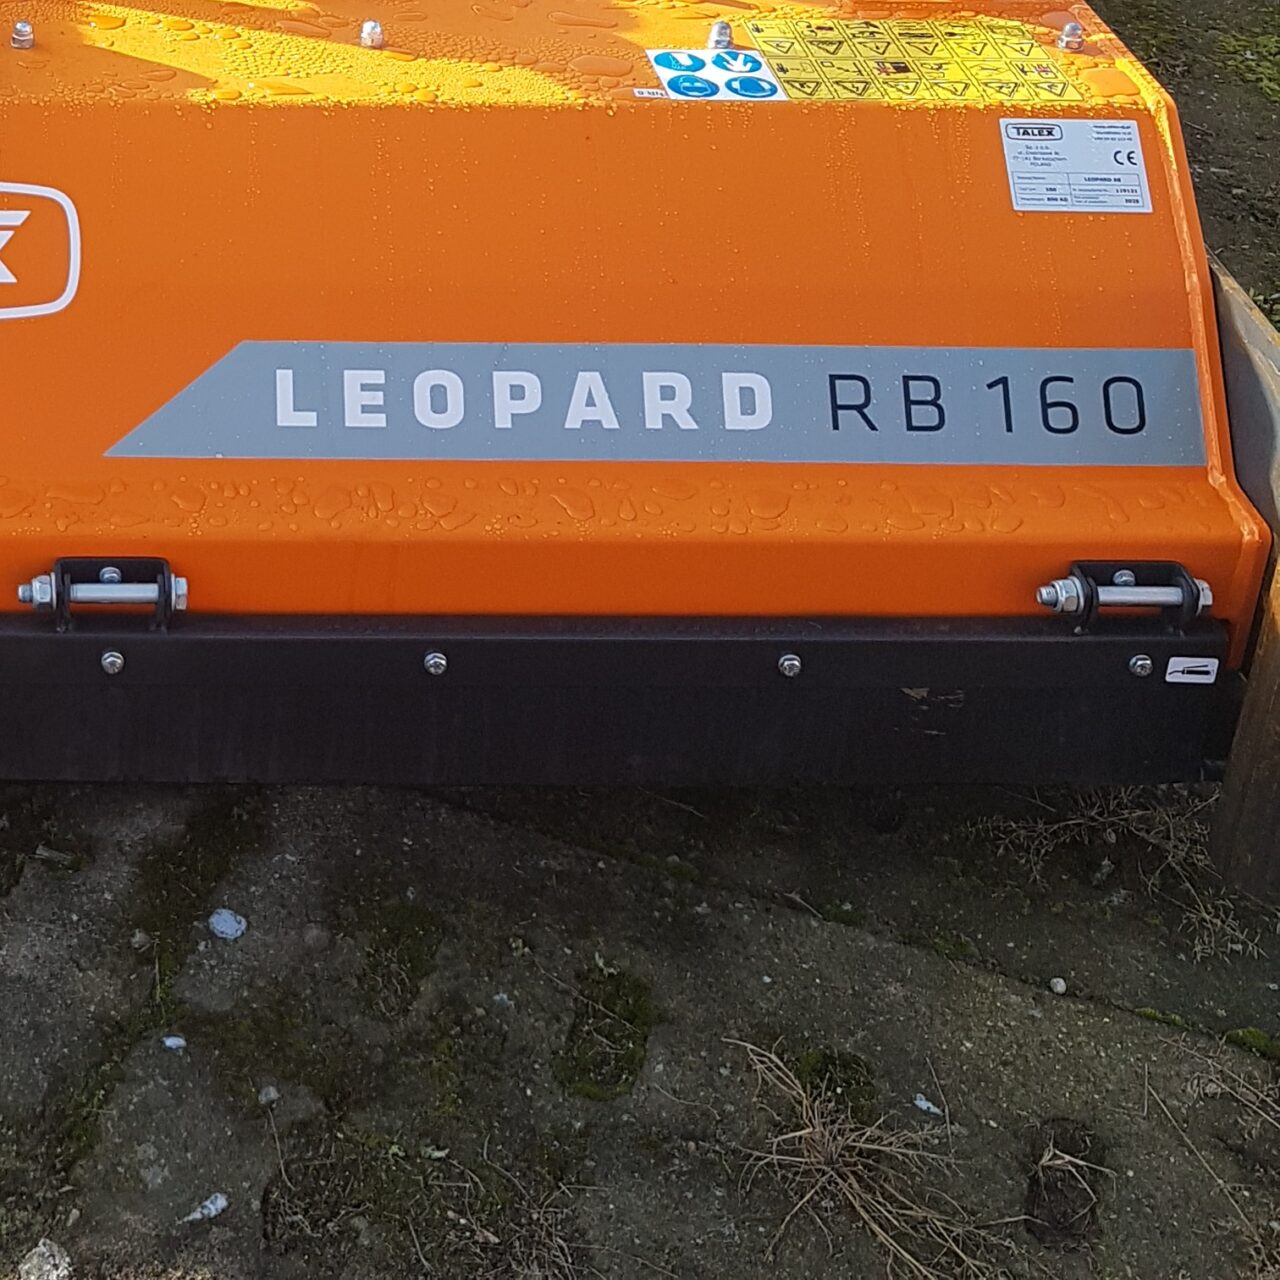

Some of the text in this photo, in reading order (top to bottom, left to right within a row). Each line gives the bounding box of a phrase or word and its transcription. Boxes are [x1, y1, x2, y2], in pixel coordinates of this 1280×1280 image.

[1012, 126, 1057, 137] TALEX
[275, 369, 1147, 435] LEOPARD RB 160
